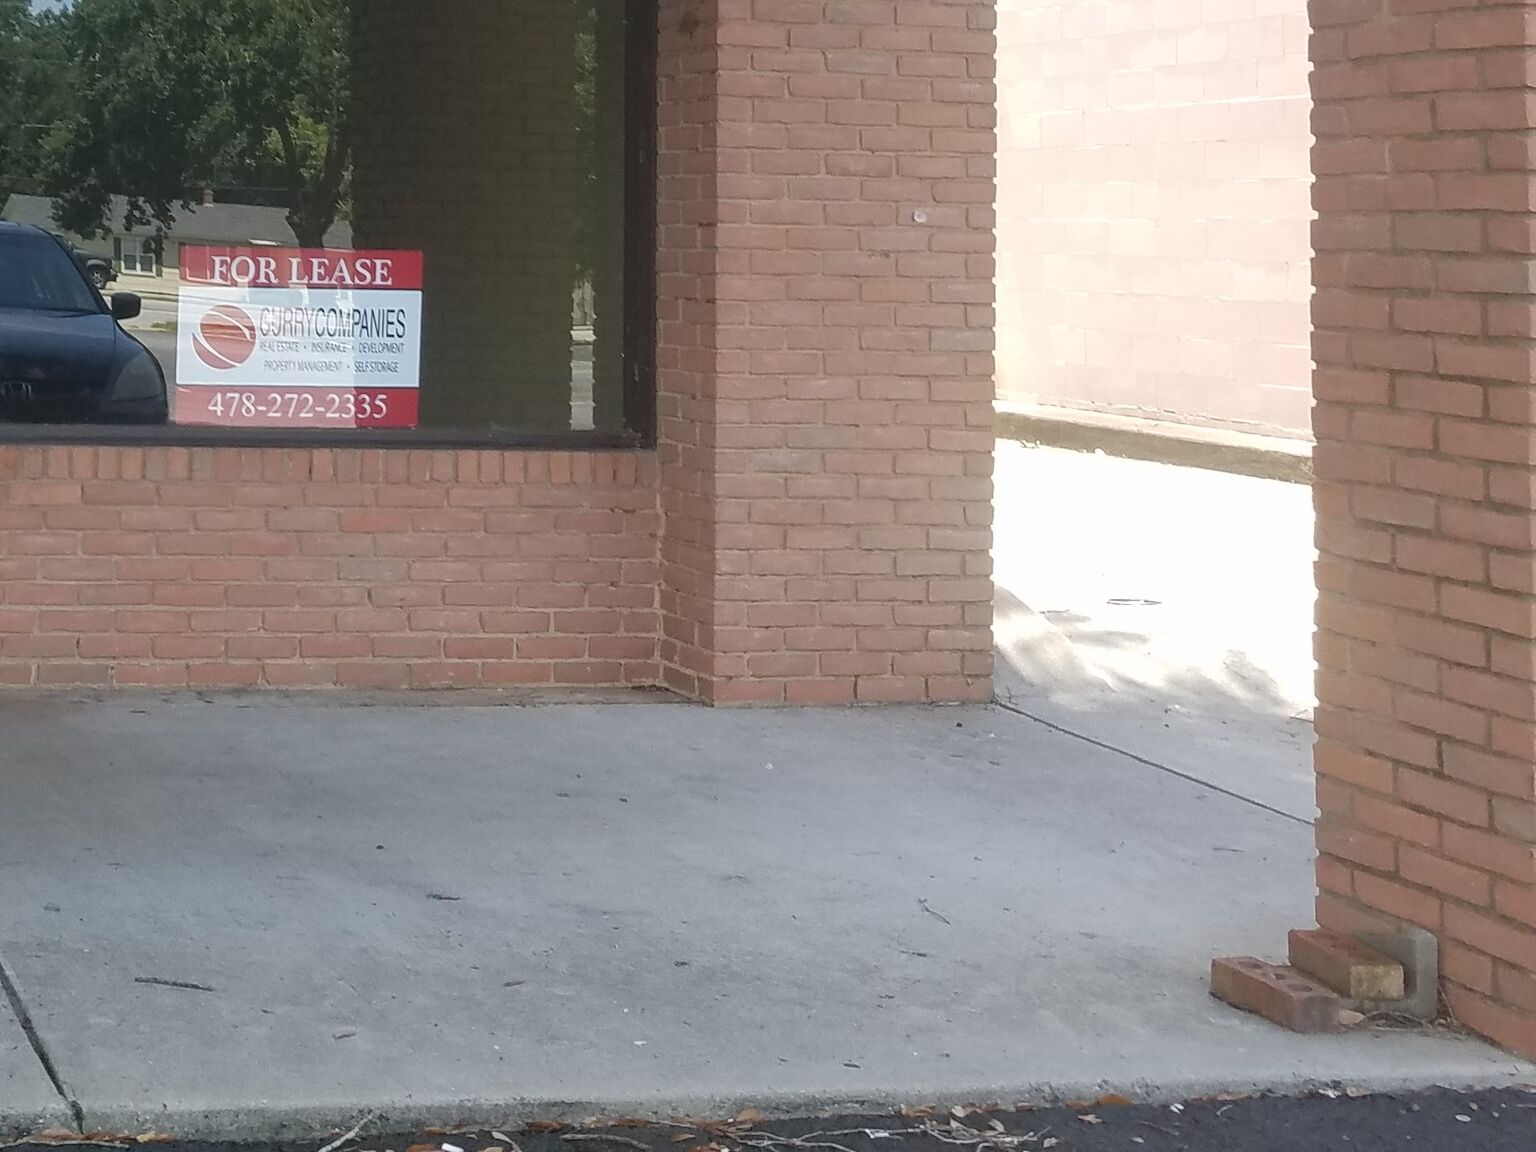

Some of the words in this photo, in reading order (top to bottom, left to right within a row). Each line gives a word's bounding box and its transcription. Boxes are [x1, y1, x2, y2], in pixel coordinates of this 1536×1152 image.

[210, 255, 279, 284] FOR
[287, 257, 393, 286] LEASE
[311, 343, 348, 353] INSURANCE
[358, 342, 405, 354] DEVELOPMENT
[264, 360, 297, 372] PROPERTY
[298, 360, 343, 373] MANAGEMENT
[207, 392, 388, 419] 478-272-2335
